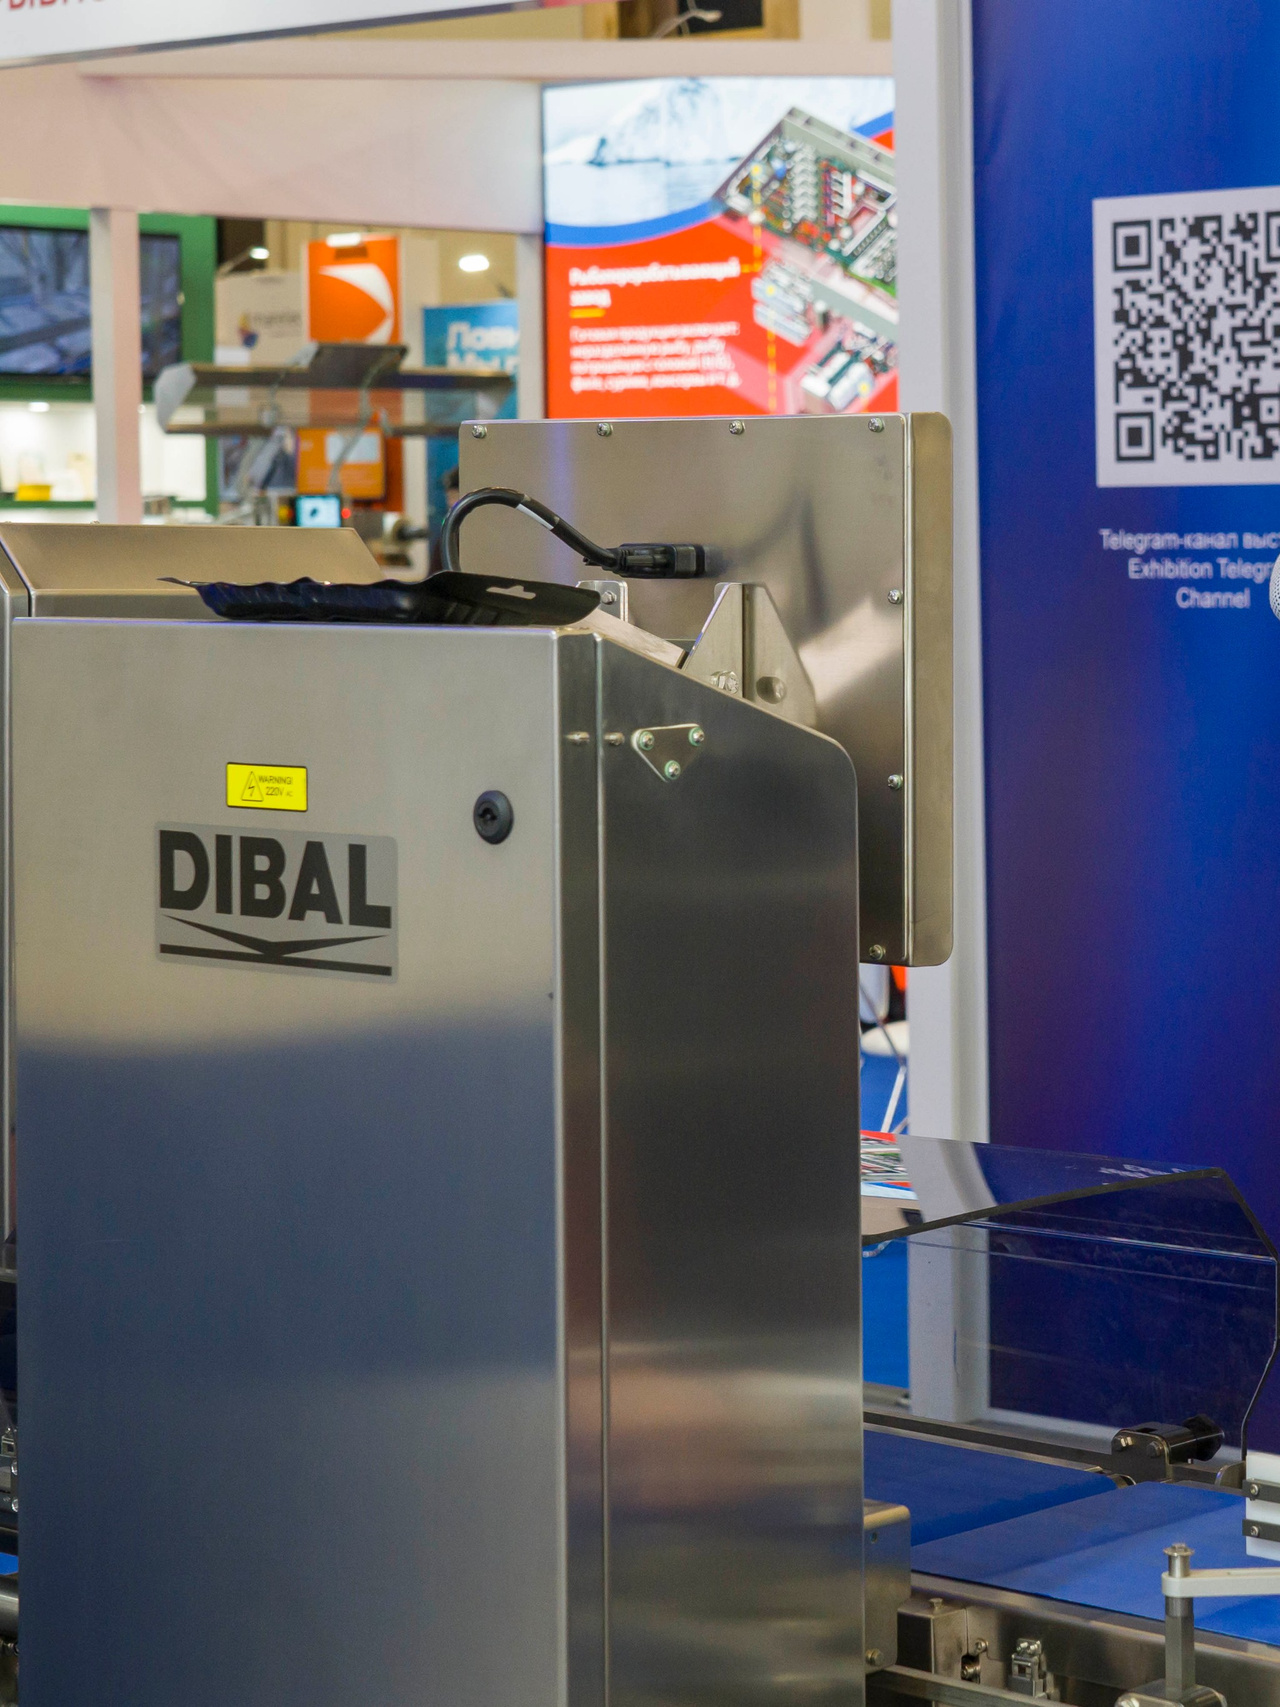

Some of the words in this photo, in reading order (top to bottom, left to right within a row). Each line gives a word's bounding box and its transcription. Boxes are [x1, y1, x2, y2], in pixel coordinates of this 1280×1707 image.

[1128, 557, 1214, 579] Exhibition
[1176, 586, 1251, 609] Channel
[159, 829, 392, 929] DIBAL
